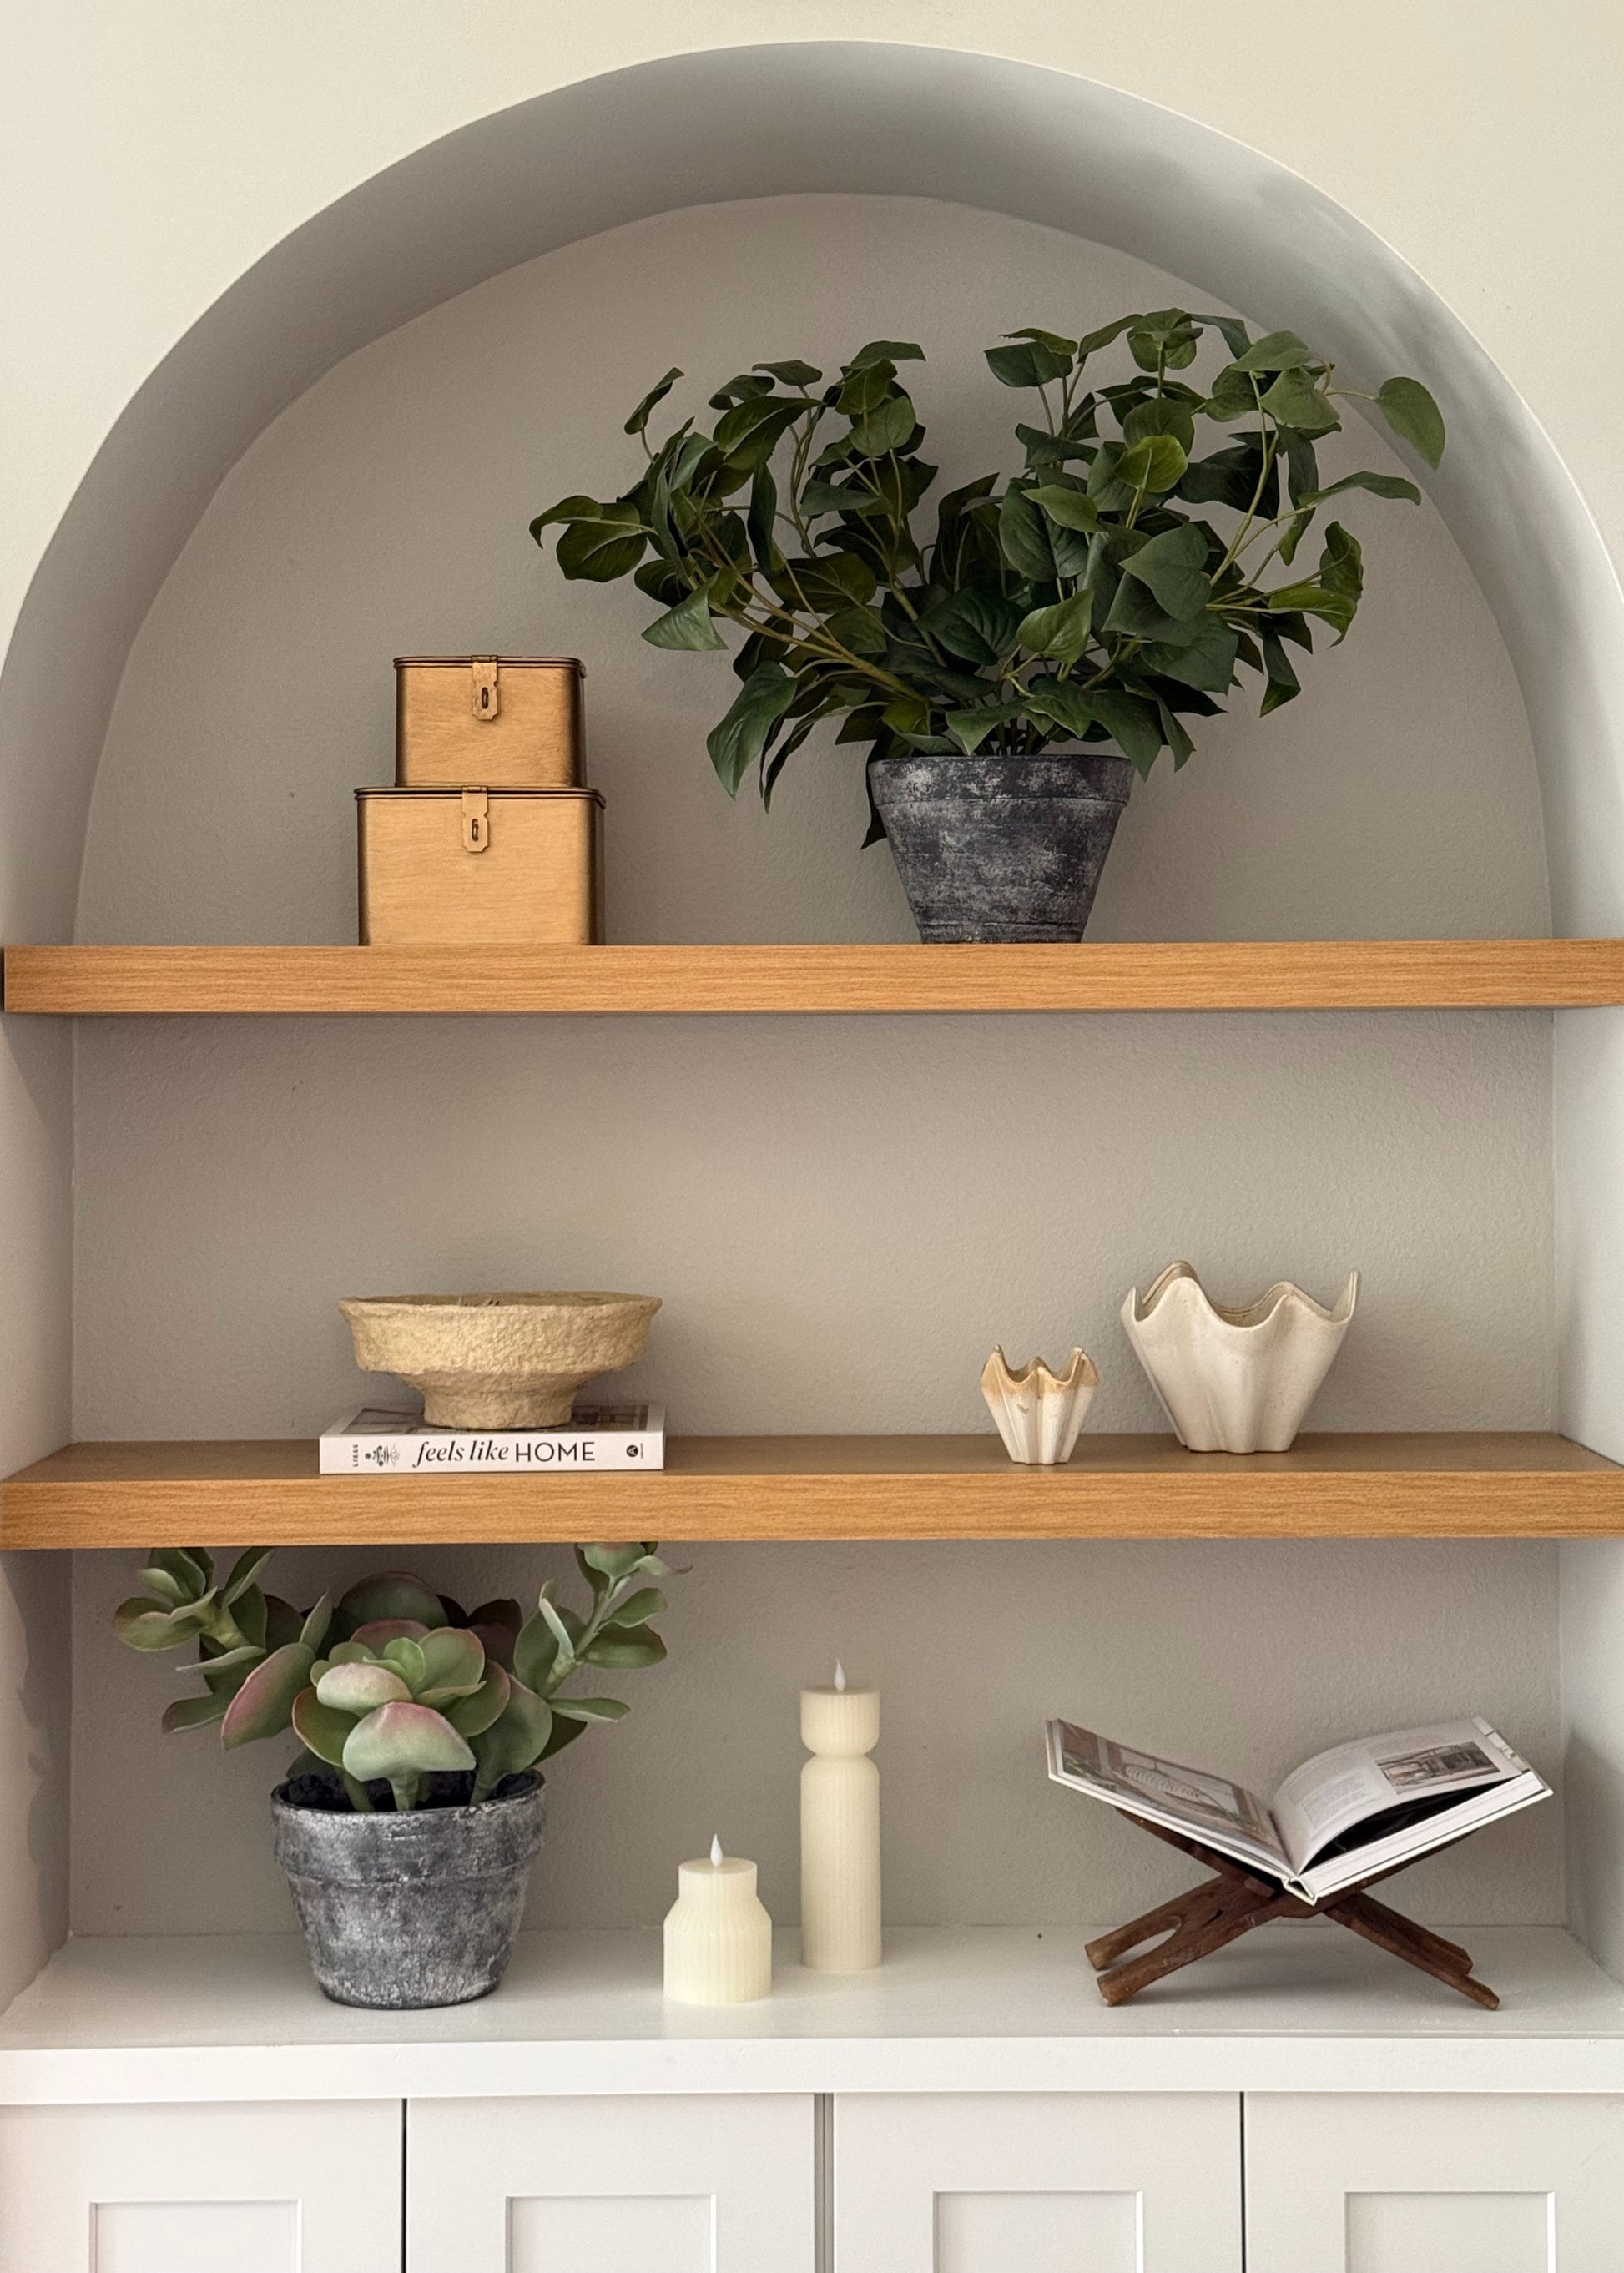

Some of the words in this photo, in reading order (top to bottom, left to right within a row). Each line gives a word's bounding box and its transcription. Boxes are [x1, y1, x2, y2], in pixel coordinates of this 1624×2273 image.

[412, 1440, 465, 1468] feels
[469, 1440, 509, 1461] like
[515, 1441, 596, 1462] HOME
